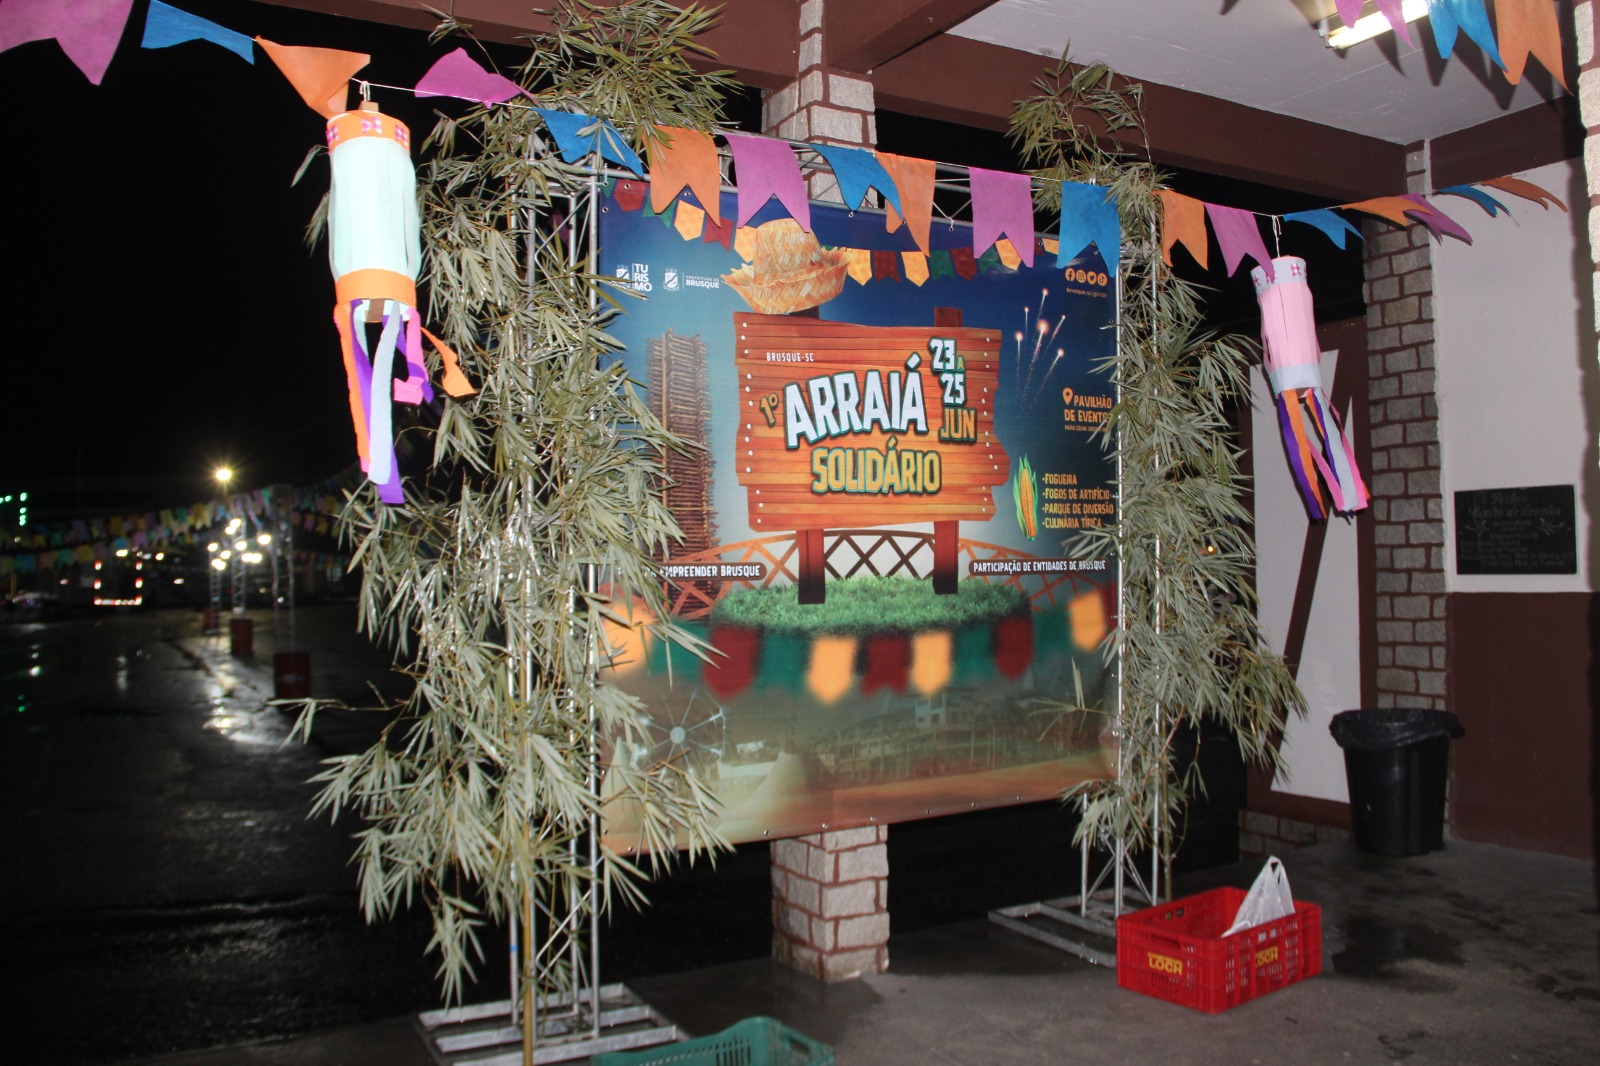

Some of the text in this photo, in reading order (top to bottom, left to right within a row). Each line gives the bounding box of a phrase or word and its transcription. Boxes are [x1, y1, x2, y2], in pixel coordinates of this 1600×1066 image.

[634, 263, 649, 273] TU
[634, 273, 649, 283] RIS
[685, 279, 720, 289] BRUSQUE
[634, 282, 653, 292] MO
[766, 352, 815, 362] BRUSQUE-SC
[930, 338, 957, 371] 23
[941, 373, 966, 405] 25
[785, 352, 928, 448] ARRAIÁ
[1074, 394, 1112, 409] PAVILHÃO
[1064, 409, 1110, 423] DE EVENTO
[940, 408, 976, 441] JUN
[811, 436, 942, 494] SOLIDÁRIO
[1045, 473, 1078, 485] FOGUEIRA
[1045, 486, 1110, 500] FOGOS DE ARTIFÍCIO
[1044, 502, 1114, 515] PARQUE DE DIVERSÃO
[1044, 515, 1080, 529] CULINÁRIA
[720, 565, 760, 577] BRUSQUE
[973, 560, 1106, 574] PARTICIPAÇÃO DE ENTIDADES DE BRUSQUE
